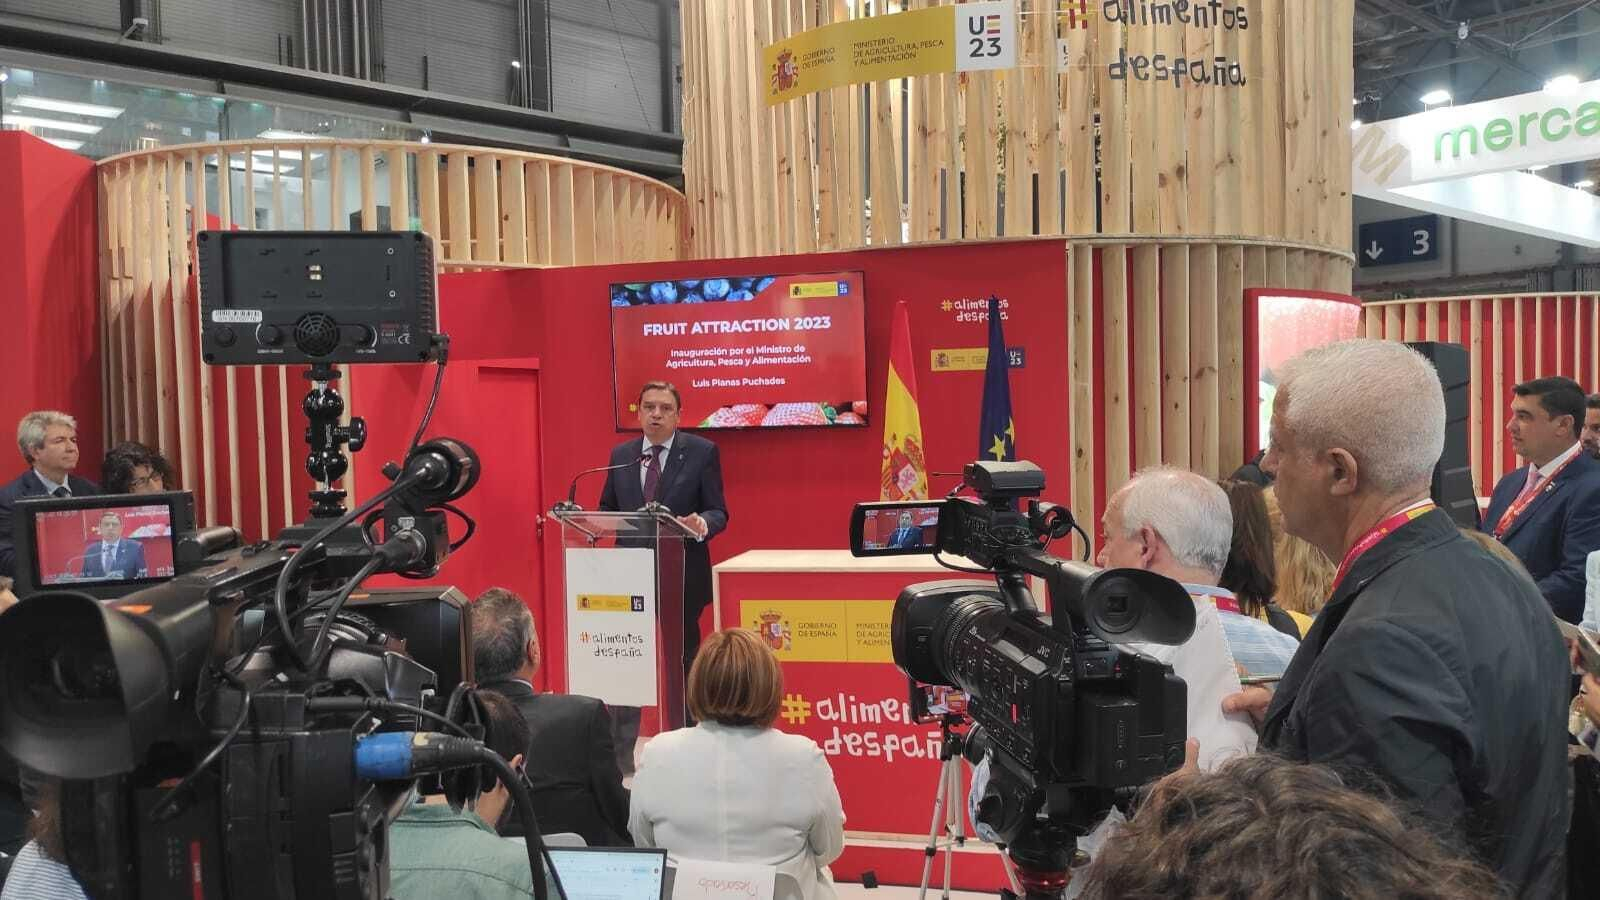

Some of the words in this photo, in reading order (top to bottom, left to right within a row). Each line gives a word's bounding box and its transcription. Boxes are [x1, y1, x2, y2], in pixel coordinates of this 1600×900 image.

[853, 37, 895, 49] MINISTERIO
[853, 50, 864, 58] DE
[864, 43, 919, 57] AGRICULTURA,
[920, 39, 944, 50] PESCA
[968, 36, 1002, 58] 23
[802, 47, 836, 60] GOBIERNO
[860, 51, 917, 66] ALIMENTACIÓN
[802, 61, 812, 70] DE
[812, 56, 835, 68] ESPAÑA
[1109, 48, 1247, 89] despaña
[1434, 100, 1600, 162] merca
[1412, 230, 1430, 256] 3
[956, 311, 1009, 323] despaa
[643, 322, 688, 337] FRUIT
[691, 318, 790, 335] ATTRACTION
[793, 315, 832, 330] 2023
[670, 347, 728, 359] Inauguración
[729, 347, 745, 356] por
[746, 345, 755, 354] el
[756, 344, 792, 354] Ministro
[793, 344, 806, 353] de
[665, 358, 717, 369] Agricultura,
[717, 357, 744, 367] Pesca
[744, 357, 751, 367] y
[751, 354, 812, 365] Alimentación
[692, 378, 711, 388] Luis
[711, 378, 741, 387] Planas
[741, 376, 786, 386] Puchades
[798, 622, 838, 630] GOBIERNO
[578, 631, 643, 643] #alimentos
[798, 630, 808, 638] DE
[809, 630, 838, 638] ESPAÑA
[856, 630, 866, 638] DE
[868, 630, 891, 638] AGRIC
[594, 646, 642, 657] despaña
[824, 726, 942, 762] despañ
